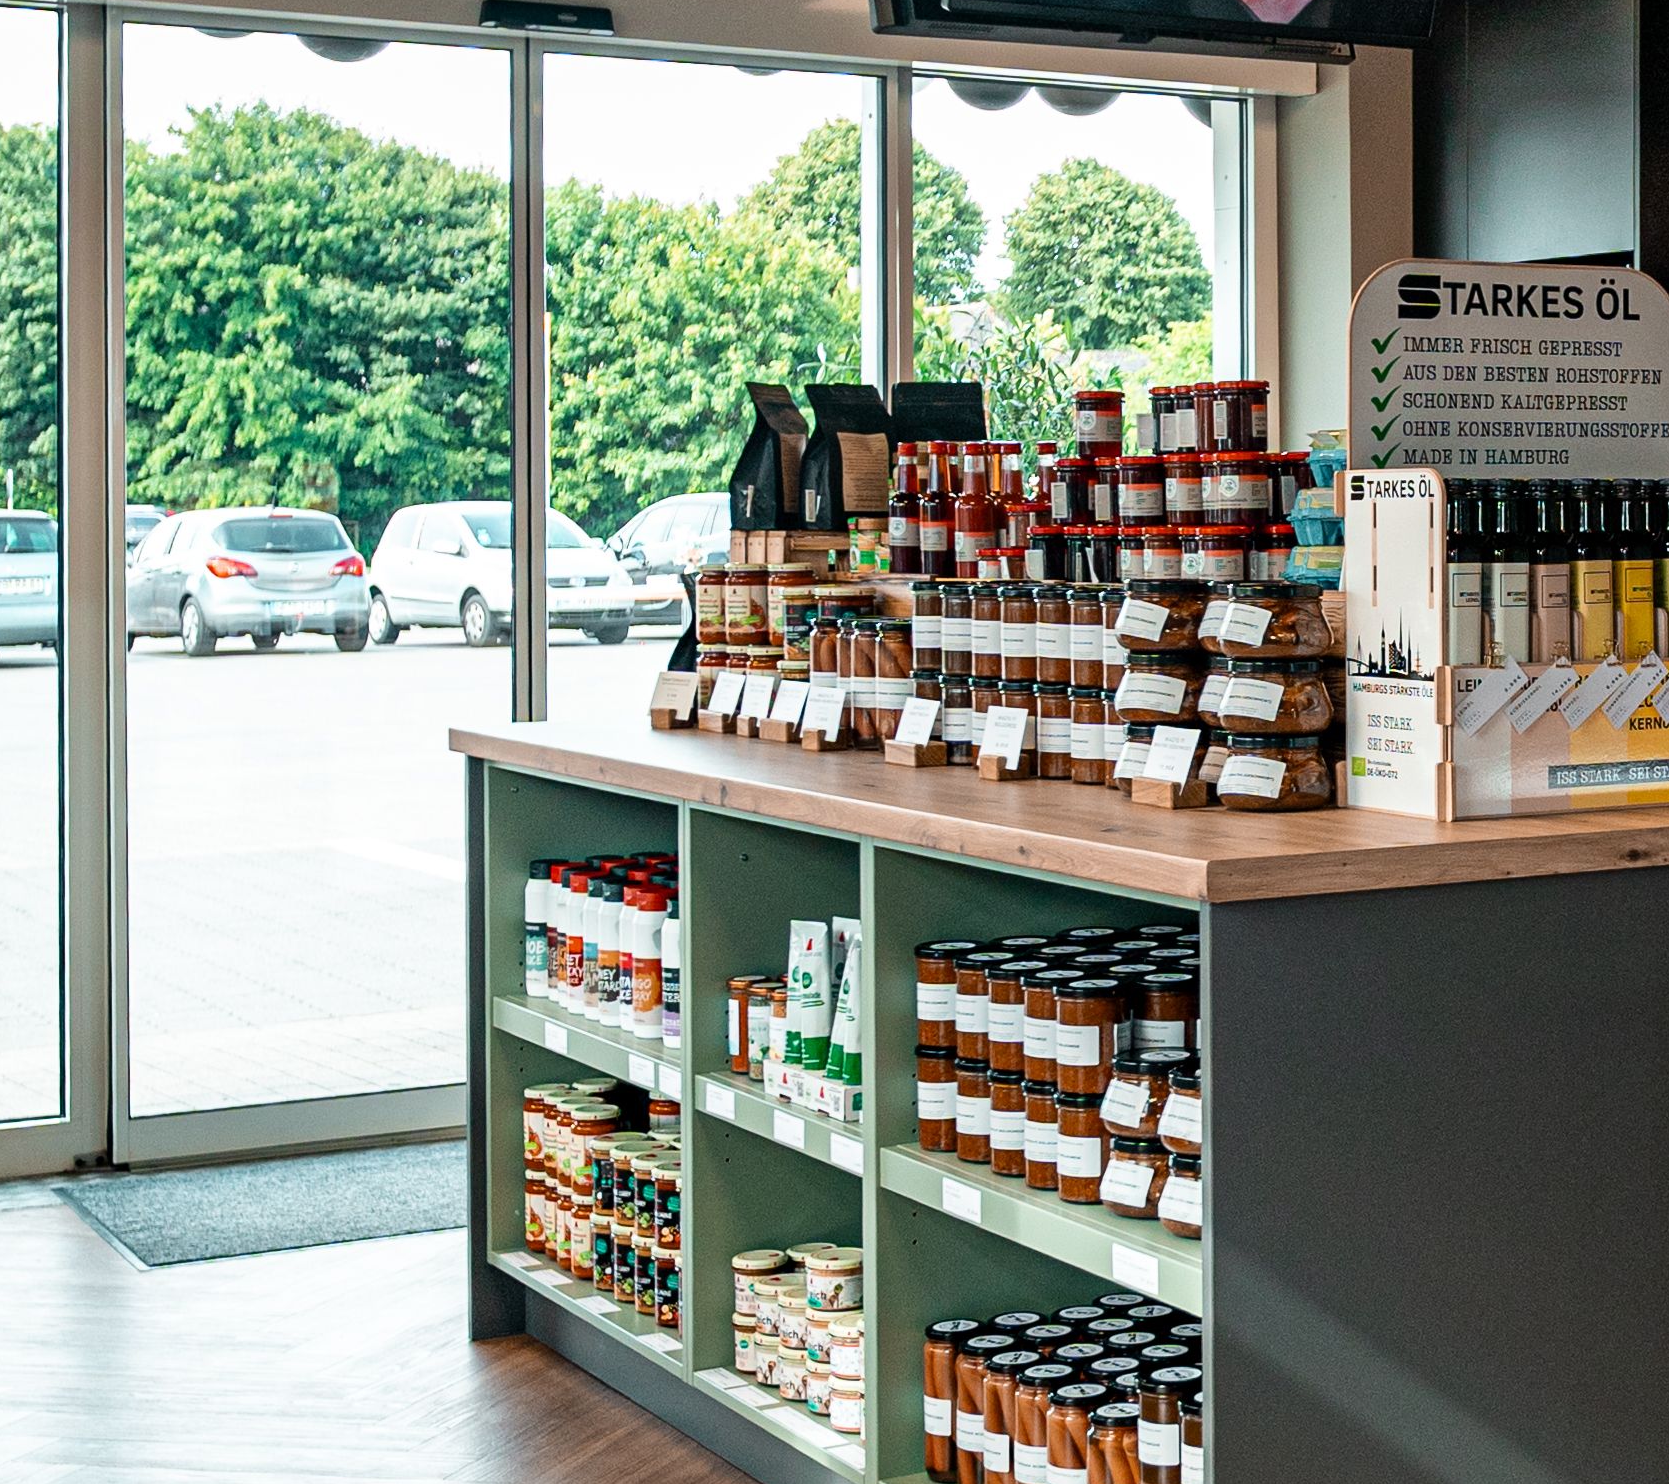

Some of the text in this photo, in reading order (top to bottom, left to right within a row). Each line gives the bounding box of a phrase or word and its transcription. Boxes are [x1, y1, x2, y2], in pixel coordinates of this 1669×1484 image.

[1398, 273, 1641, 322] STARKES ÖL
[1403, 336, 1623, 357] IMMER FRISCH GEPRESST
[1403, 365, 1663, 385] AUS DEN BESTEN ROHSTOFFEN
[1402, 392, 1628, 411] SCHONEND KALTGEPRESST
[1402, 420, 1451, 437] OHNE
[1403, 448, 1569, 466] MADE IN HAMBURG
[1350, 475, 1435, 501] STARKES ÖL
[1352, 682, 1388, 695] HAMBURGS
[1389, 683, 1420, 697] STÄRKSTE
[1367, 714, 1382, 727] ISS
[1367, 737, 1382, 751] SEI
[1556, 769, 1577, 785] ISS
[1628, 767, 1652, 781] SEI
